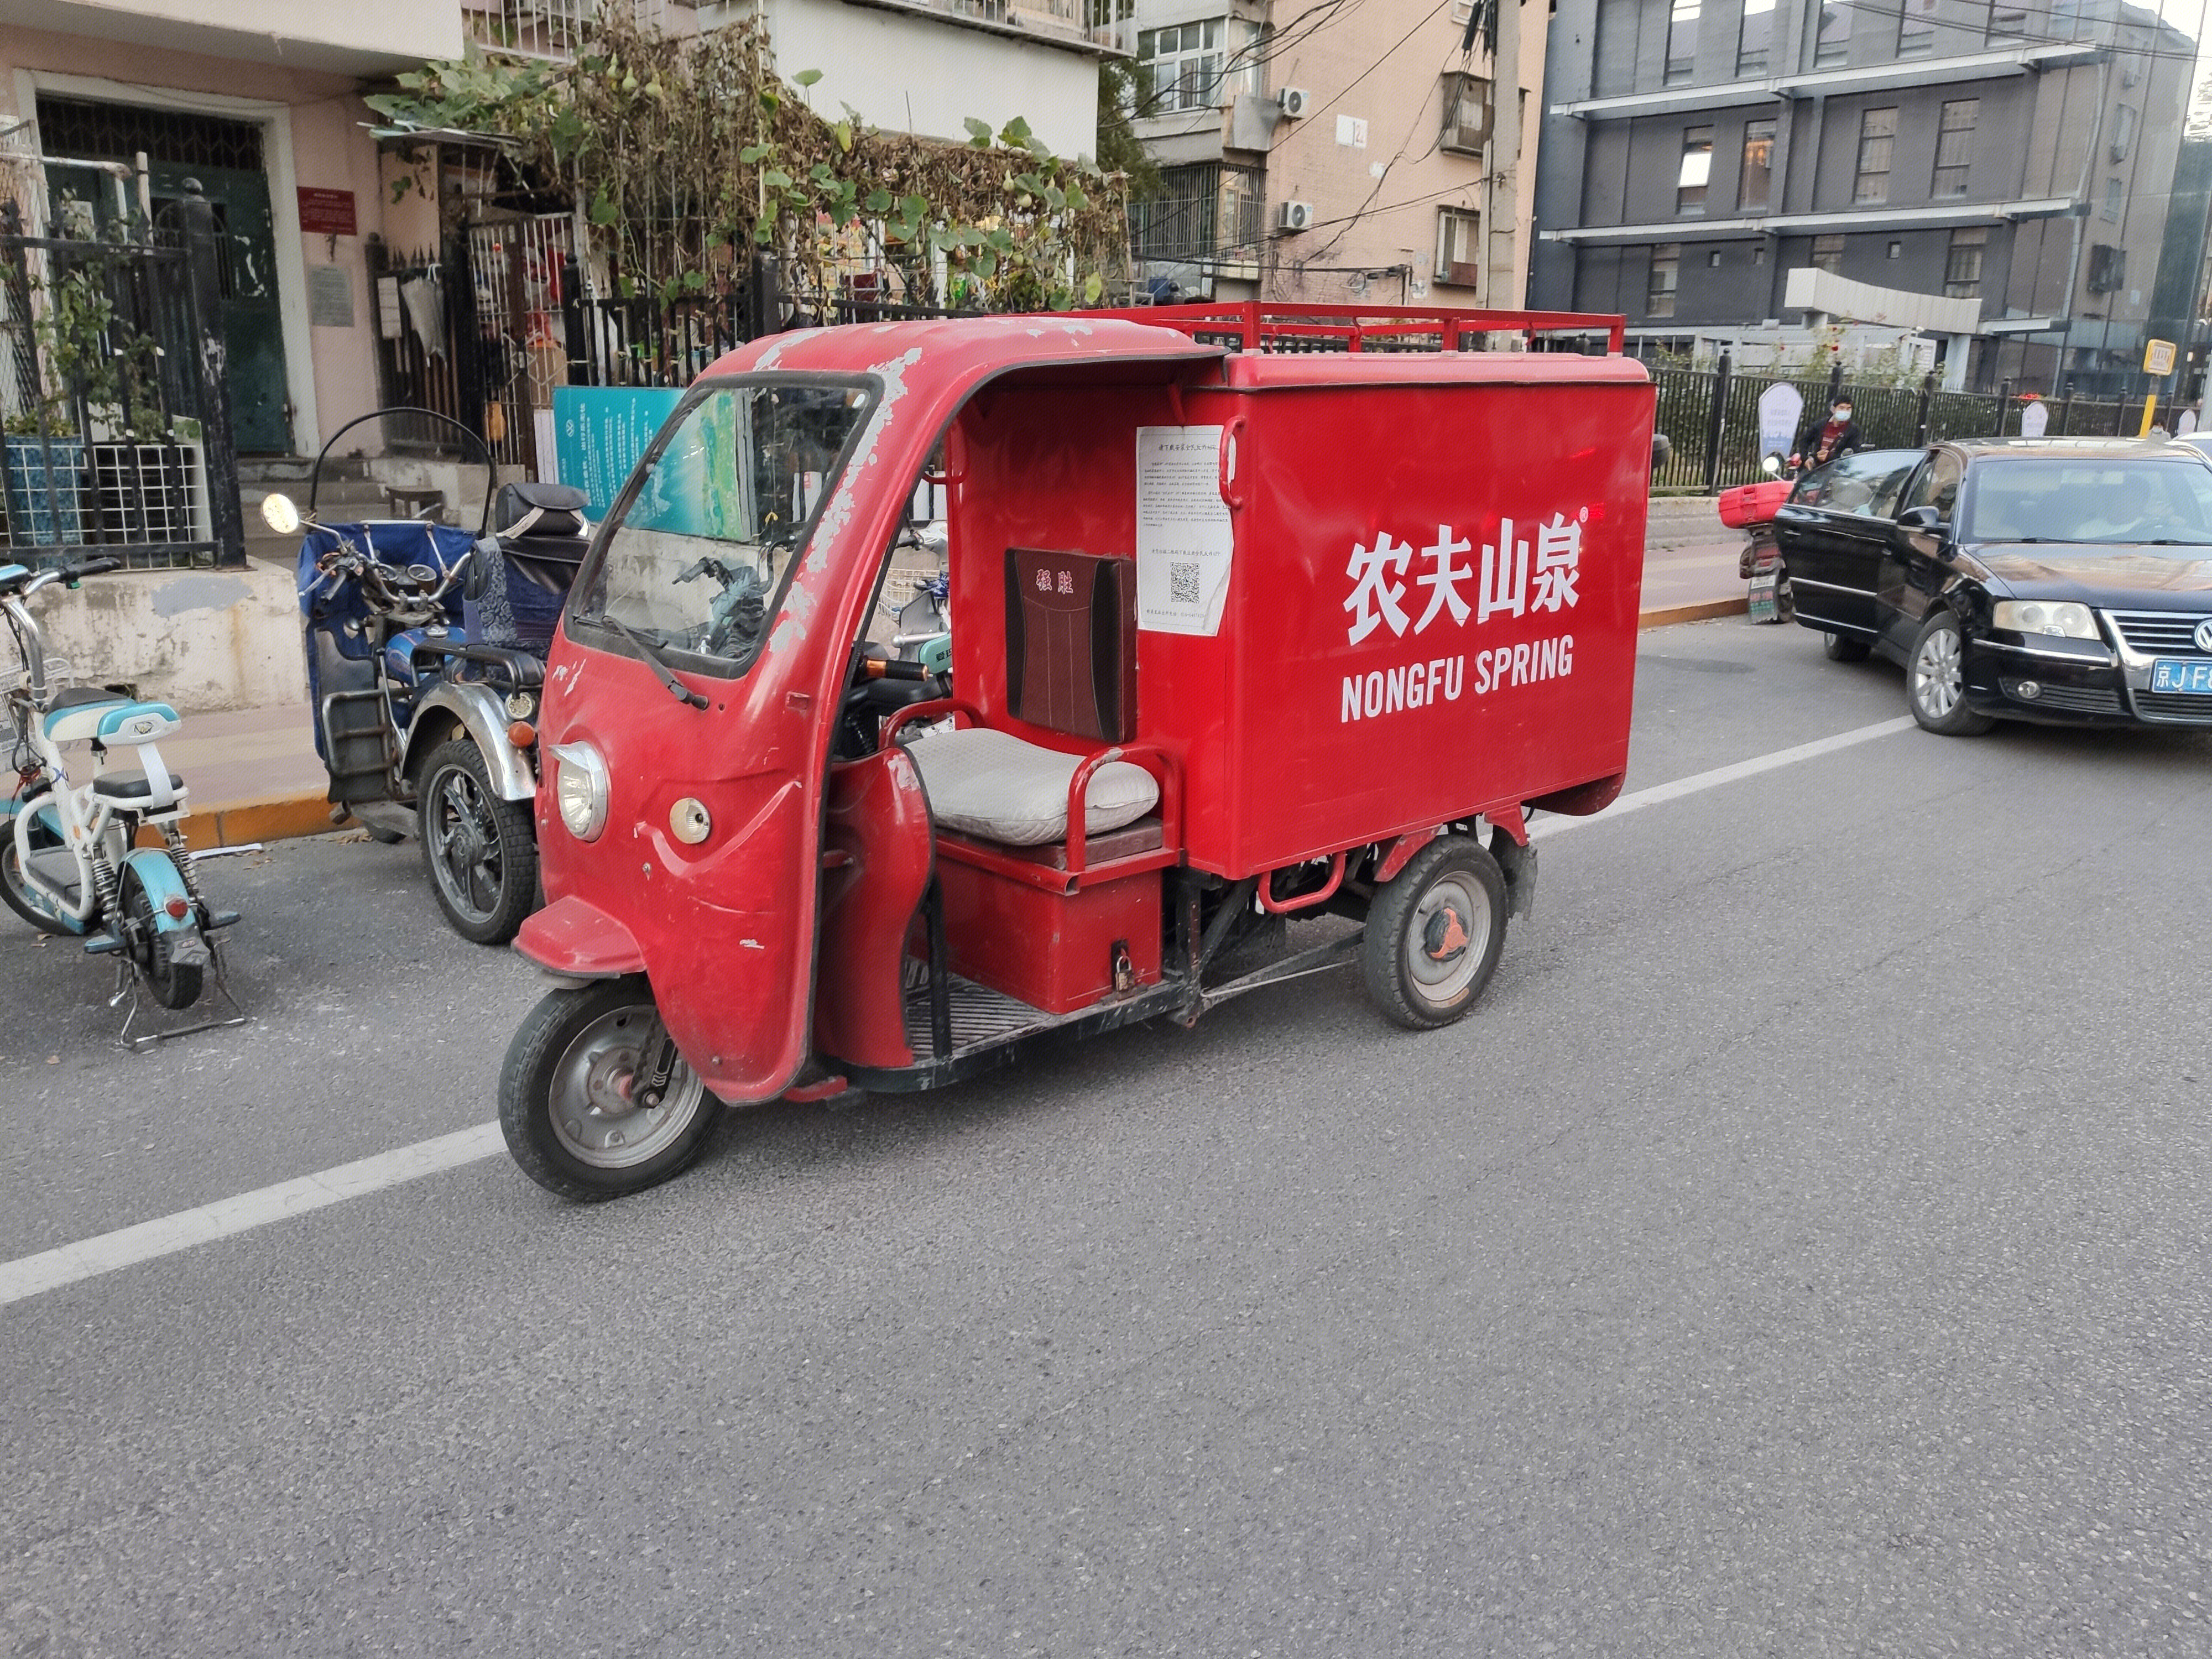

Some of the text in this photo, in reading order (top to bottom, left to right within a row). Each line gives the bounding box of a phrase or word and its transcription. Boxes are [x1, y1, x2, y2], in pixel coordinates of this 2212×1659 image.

[1343, 512, 1582, 646] 农夫山泉
[1342, 634, 1573, 723] NONGFU SPRING
